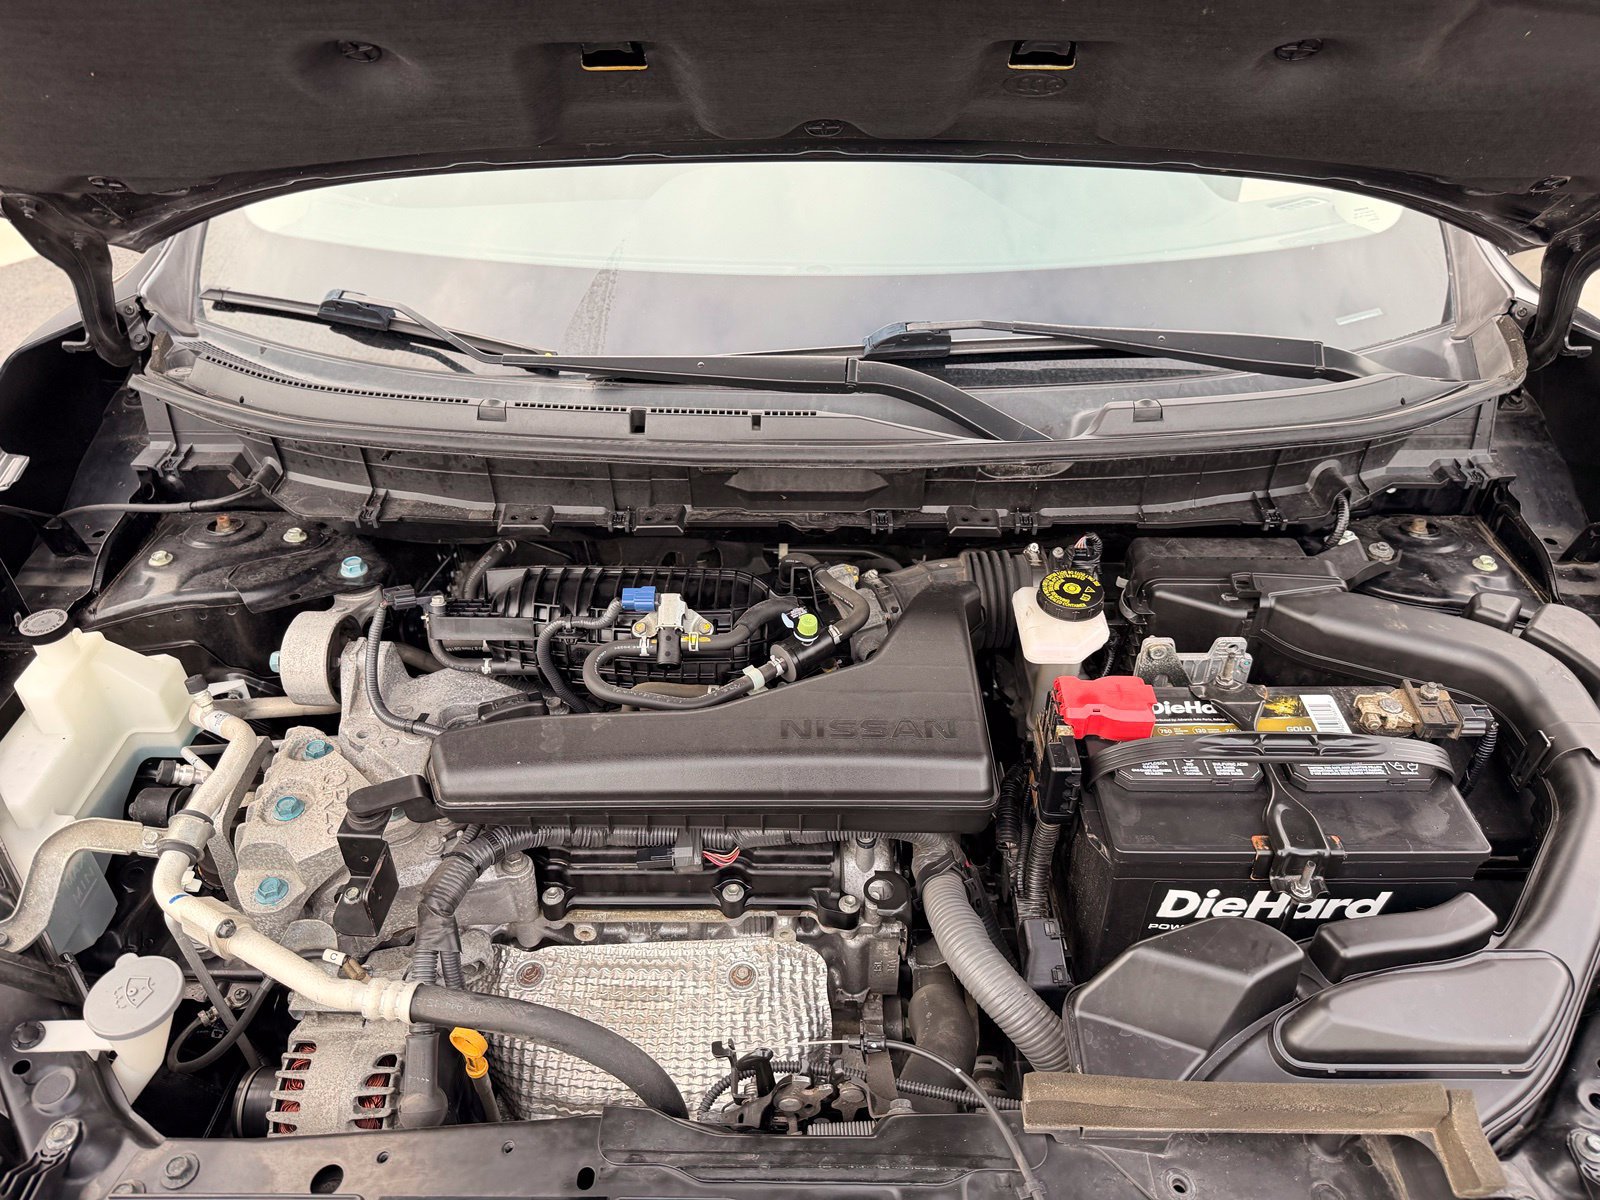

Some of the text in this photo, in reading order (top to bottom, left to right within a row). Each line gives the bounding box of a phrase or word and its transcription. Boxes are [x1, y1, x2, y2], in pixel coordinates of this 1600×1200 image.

[1152, 700, 1218, 715] DieHa
[780, 718, 957, 739] NISSAN
[1156, 889, 1393, 920] DieHard
[329, 952, 338, 961] C
